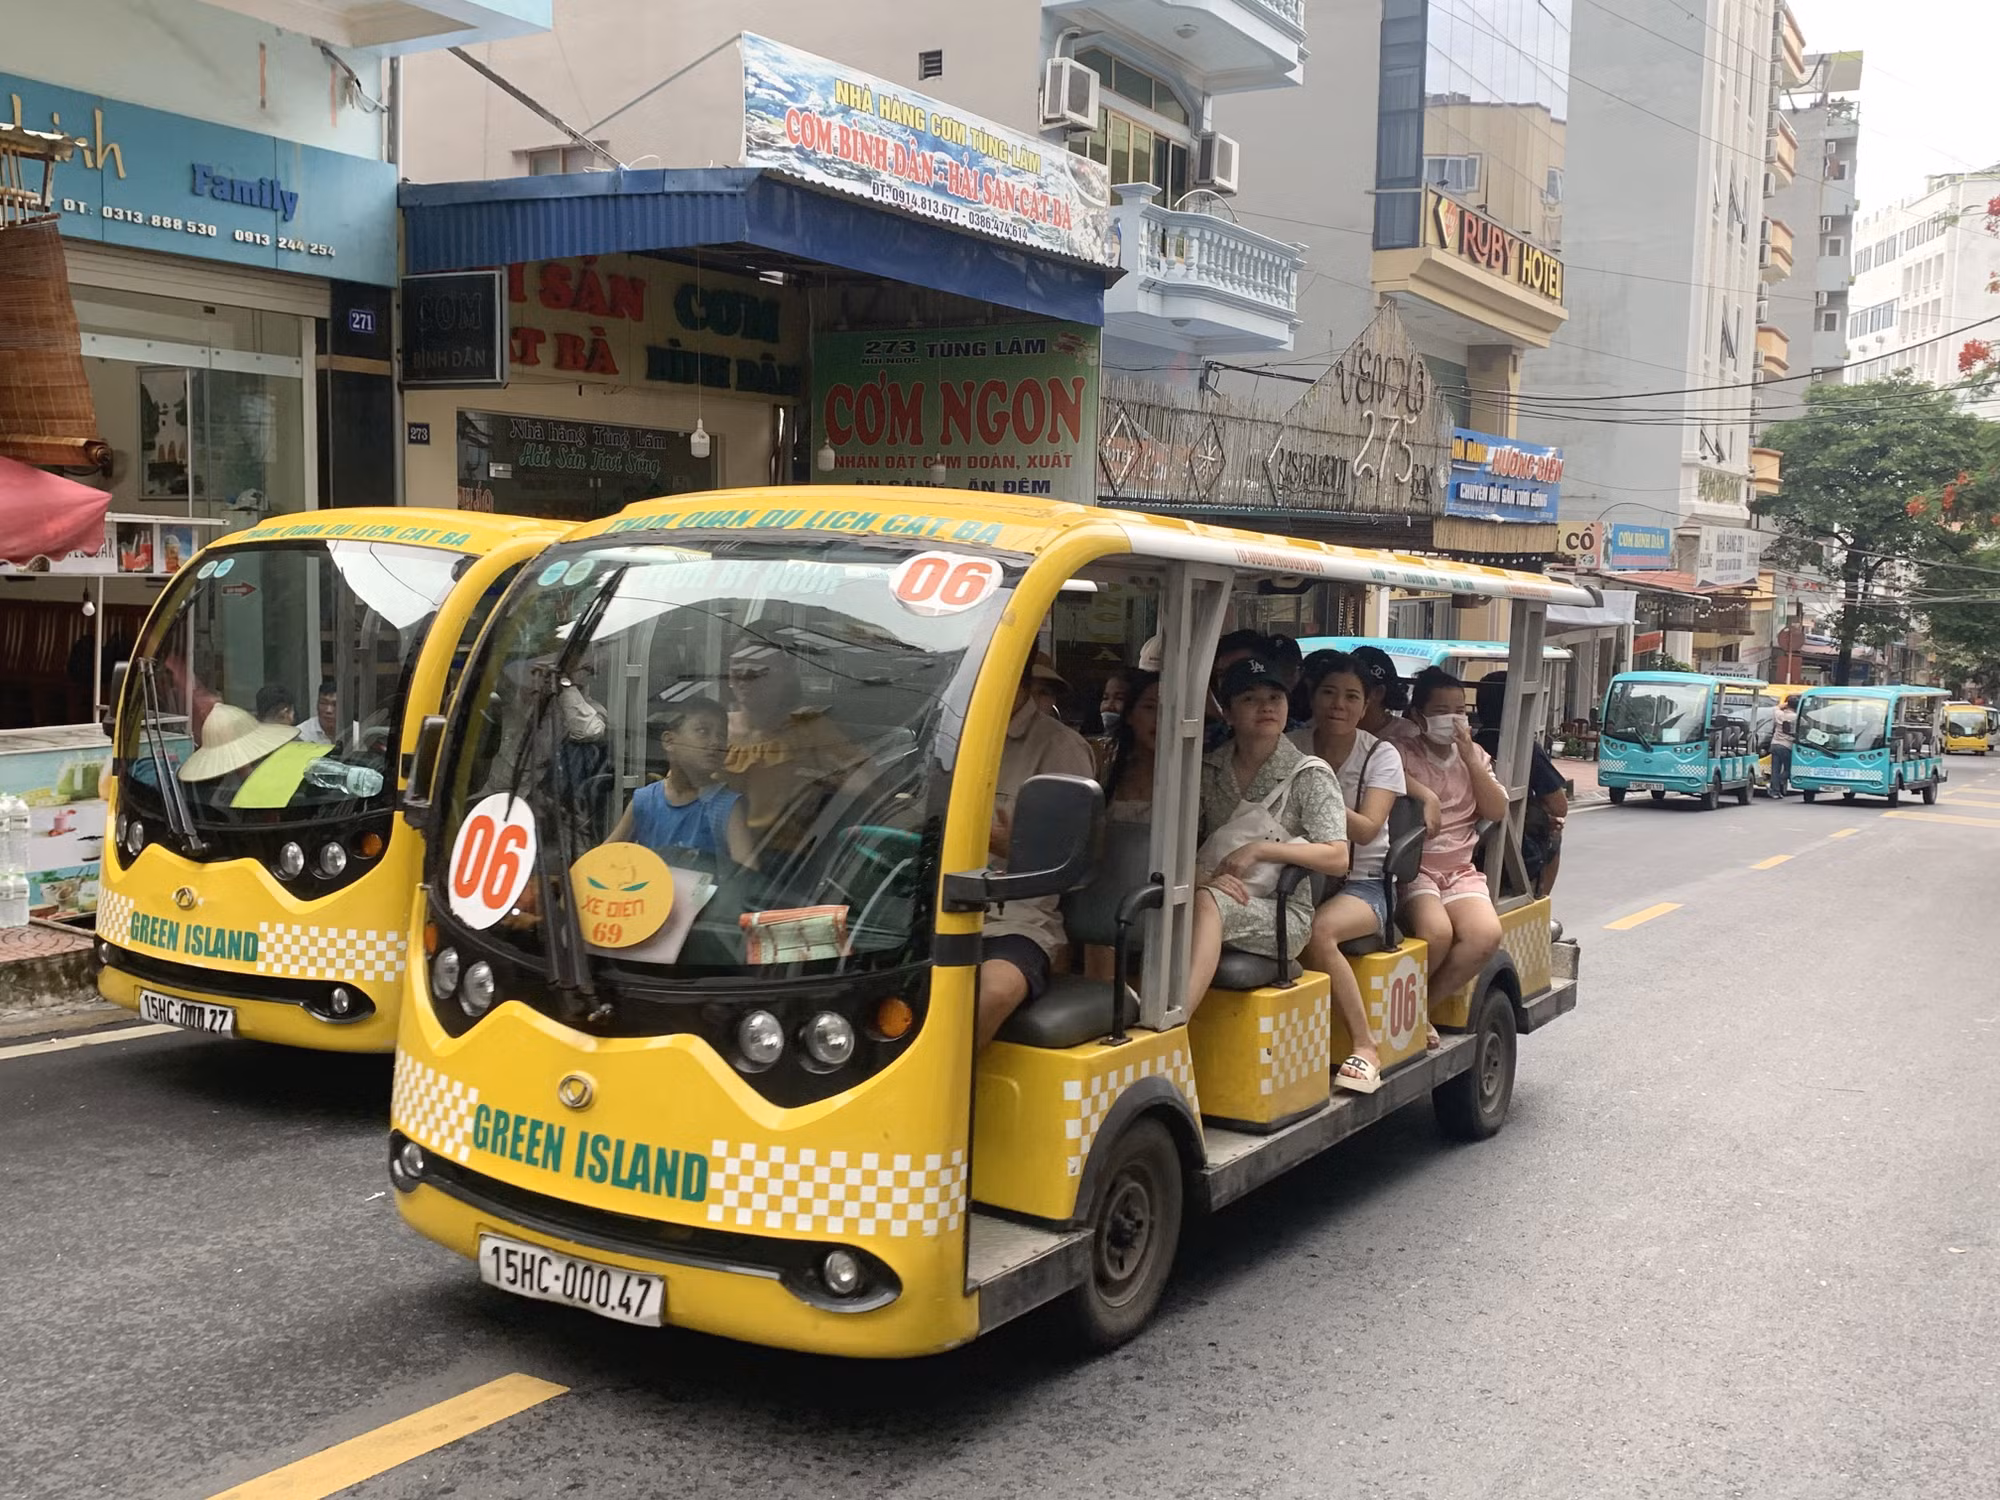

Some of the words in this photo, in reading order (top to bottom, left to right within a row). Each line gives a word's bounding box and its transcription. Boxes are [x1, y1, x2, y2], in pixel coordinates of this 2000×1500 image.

[835, 79, 874, 115] NHÀ
[879, 96, 926, 133] HÀNG
[930, 113, 967, 147] CƠM
[969, 126, 1008, 162] TÙNG
[1011, 144, 1042, 175] LÂM
[191, 161, 299, 222] Family
[785, 107, 833, 153] CƠM
[838, 119, 888, 172] BÌNH
[893, 135, 935, 189] DÂN
[948, 151, 980, 202] HẢI
[982, 167, 1017, 214] SẢN
[1019, 180, 1050, 223] CÁT
[1052, 190, 1074, 230] BÀ
[872, 179, 892, 201] ĐT:
[891, 186, 960, 222] 0914.813.677
[968, 210, 1029, 242] 0386.474.614
[234, 228, 270, 246] 0913
[278, 236, 305, 252] 244
[309, 242, 336, 258] 254
[1463, 211, 1516, 275] RUBY
[1522, 242, 1562, 300] HOTEL
[351, 312, 374, 332] 271
[553, 326, 620, 375] BÀ
[864, 339, 917, 356] 273
[925, 338, 988, 358] TÙNG
[994, 337, 1047, 357] LÂM
[825, 370, 926, 447] CƠM
[939, 375, 1087, 447] NGON
[410, 426, 430, 442] 273
[280, 524, 327, 537] QUAN
[326, 523, 354, 536] DU
[677, 508, 755, 529] QUAN
[755, 508, 804, 528] DU
[1566, 524, 1595, 551] CỒ
[899, 557, 993, 606] 06
[1248, 659, 1267, 673] LA
[454, 814, 528, 910] 06
[581, 894, 605, 913] XE
[130, 911, 180, 952] GREEN
[184, 923, 259, 963] ISLAND
[592, 921, 623, 944] 69
[1390, 973, 1417, 1037] 06
[472, 1102, 566, 1173] GREEN
[574, 1130, 709, 1204] ISLAND
[490, 1244, 652, 1320] 15HC-000.47
